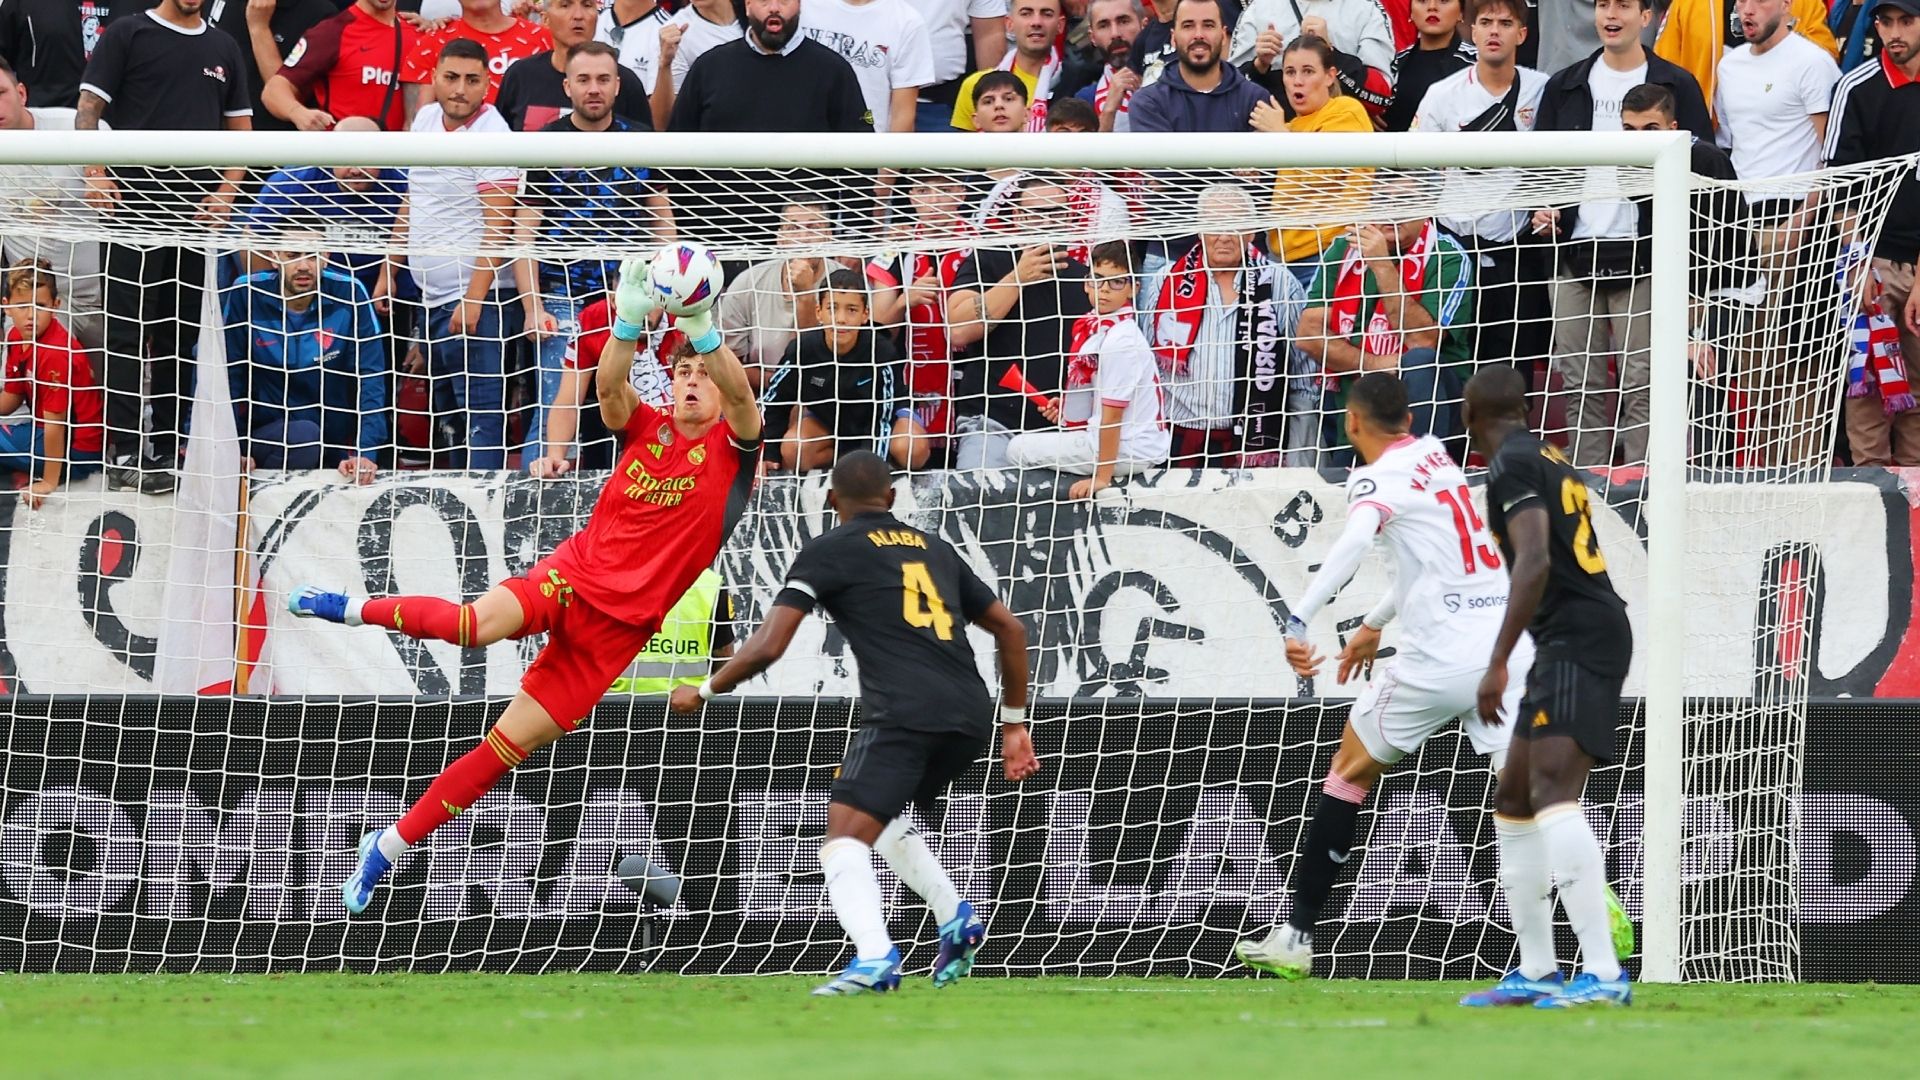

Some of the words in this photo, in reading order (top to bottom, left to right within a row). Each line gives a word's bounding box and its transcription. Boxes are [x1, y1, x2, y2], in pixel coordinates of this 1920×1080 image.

[623, 482, 646, 500] FLY
[643, 491, 682, 507] BETTER
[625, 458, 696, 491] Emirates
[867, 529, 928, 550] ALABA
[1435, 484, 1501, 575] 15
[901, 562, 954, 641] 4
[1, 785, 690, 921] OMPRA
[1044, 792, 1294, 923] LA
